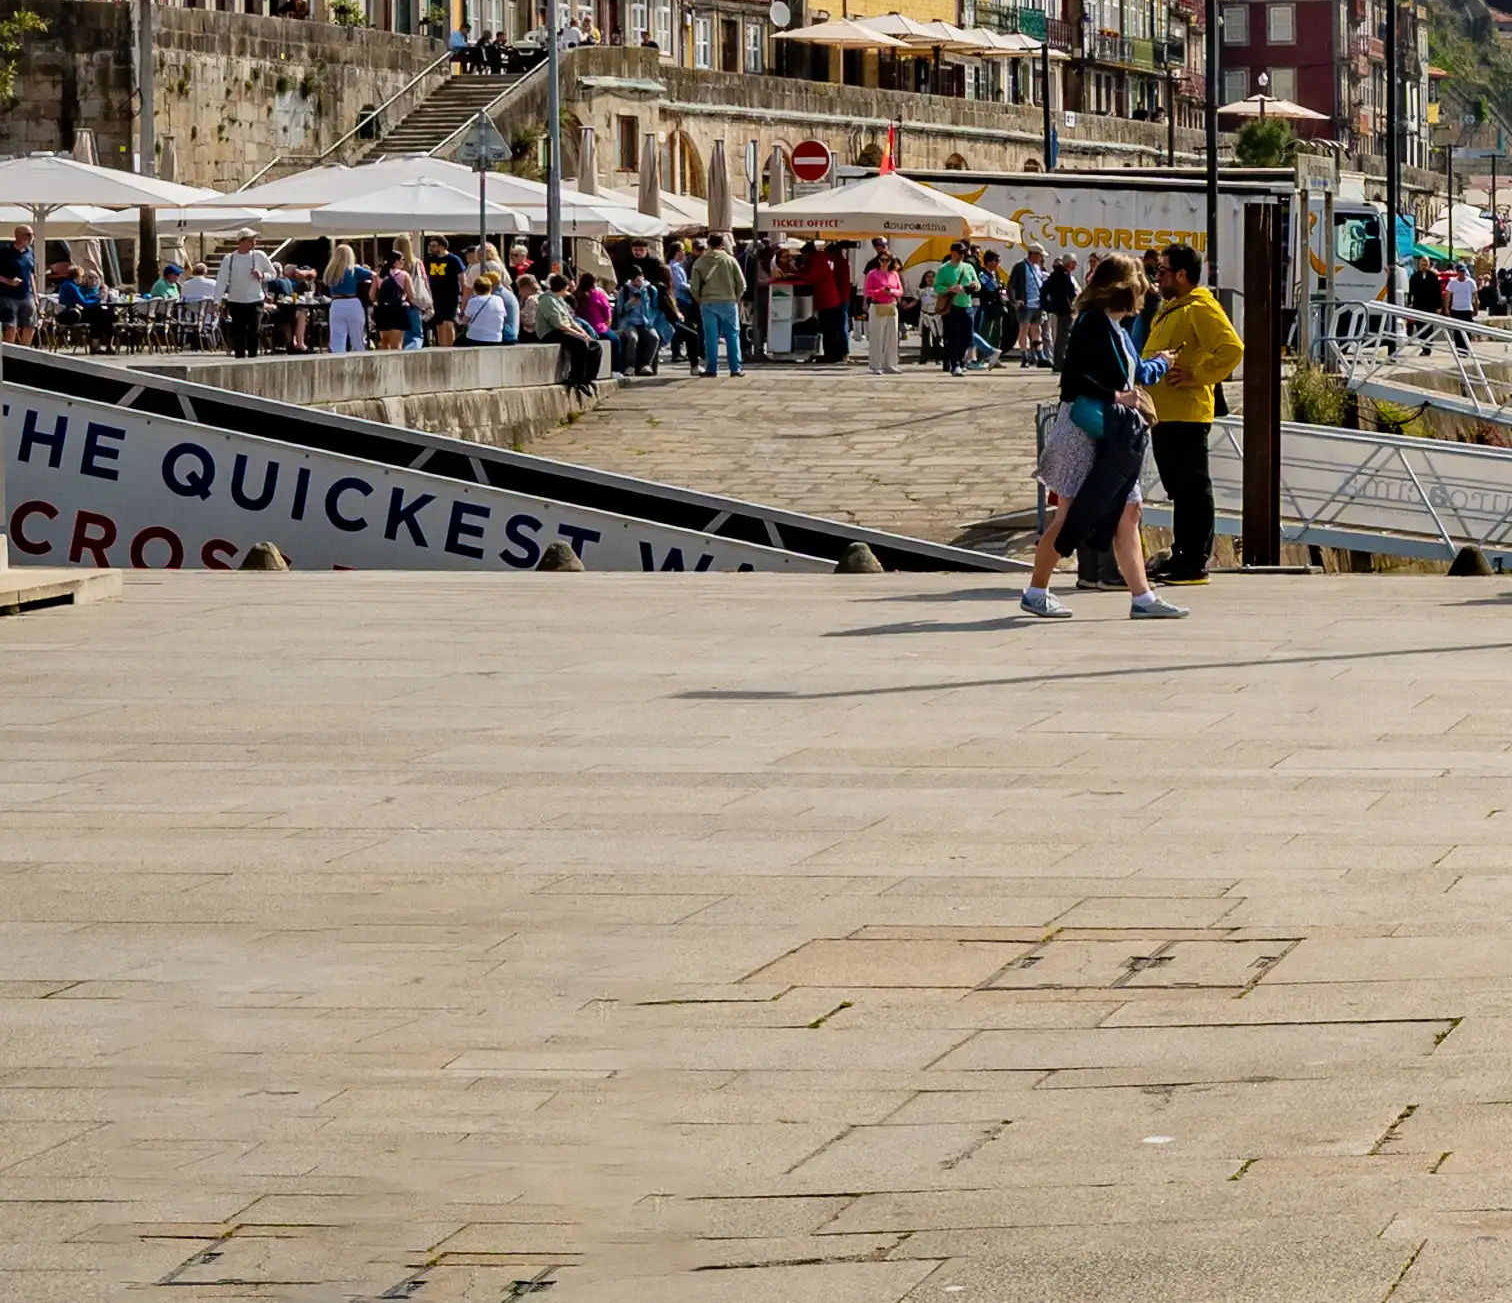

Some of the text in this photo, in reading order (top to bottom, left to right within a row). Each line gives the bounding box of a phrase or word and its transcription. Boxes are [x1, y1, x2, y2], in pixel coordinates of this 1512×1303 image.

[772, 219, 803, 228] TICKET
[883, 220, 947, 232] douroacima
[429, 262, 446, 276] M
[2, 403, 126, 481] HE
[161, 442, 601, 571] QUICKEST
